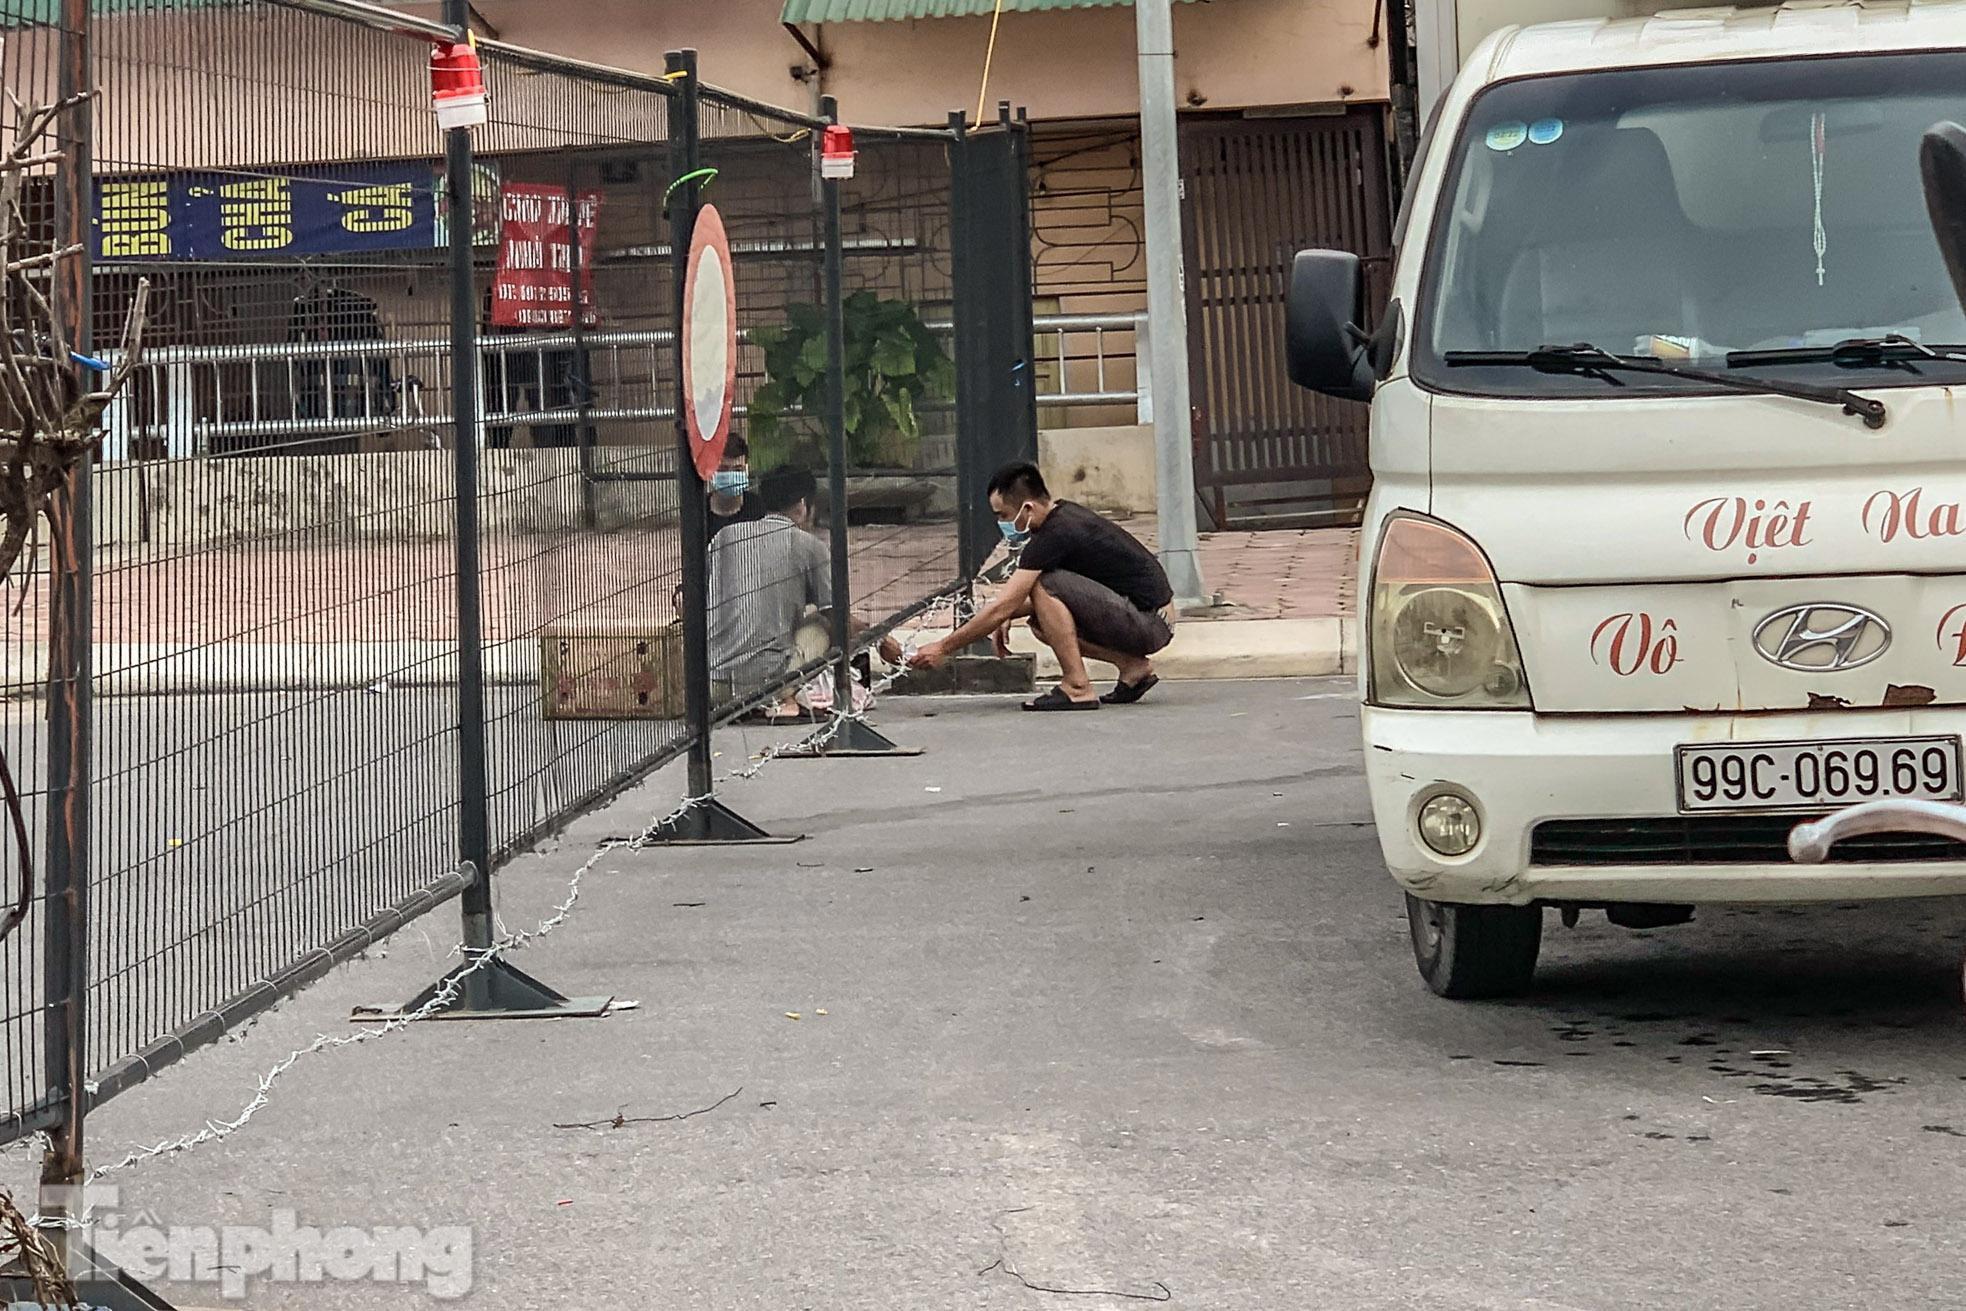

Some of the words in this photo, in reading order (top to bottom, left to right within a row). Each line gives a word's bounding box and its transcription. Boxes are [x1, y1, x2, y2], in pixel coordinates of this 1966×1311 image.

[91, 181, 172, 257] BÚN
[188, 177, 294, 250] CHẢ
[326, 182, 413, 233] CÁ
[1684, 496, 1814, 565] Việt
[1590, 612, 1684, 676] Vô
[1692, 747, 1948, 801] 99C-069.69
